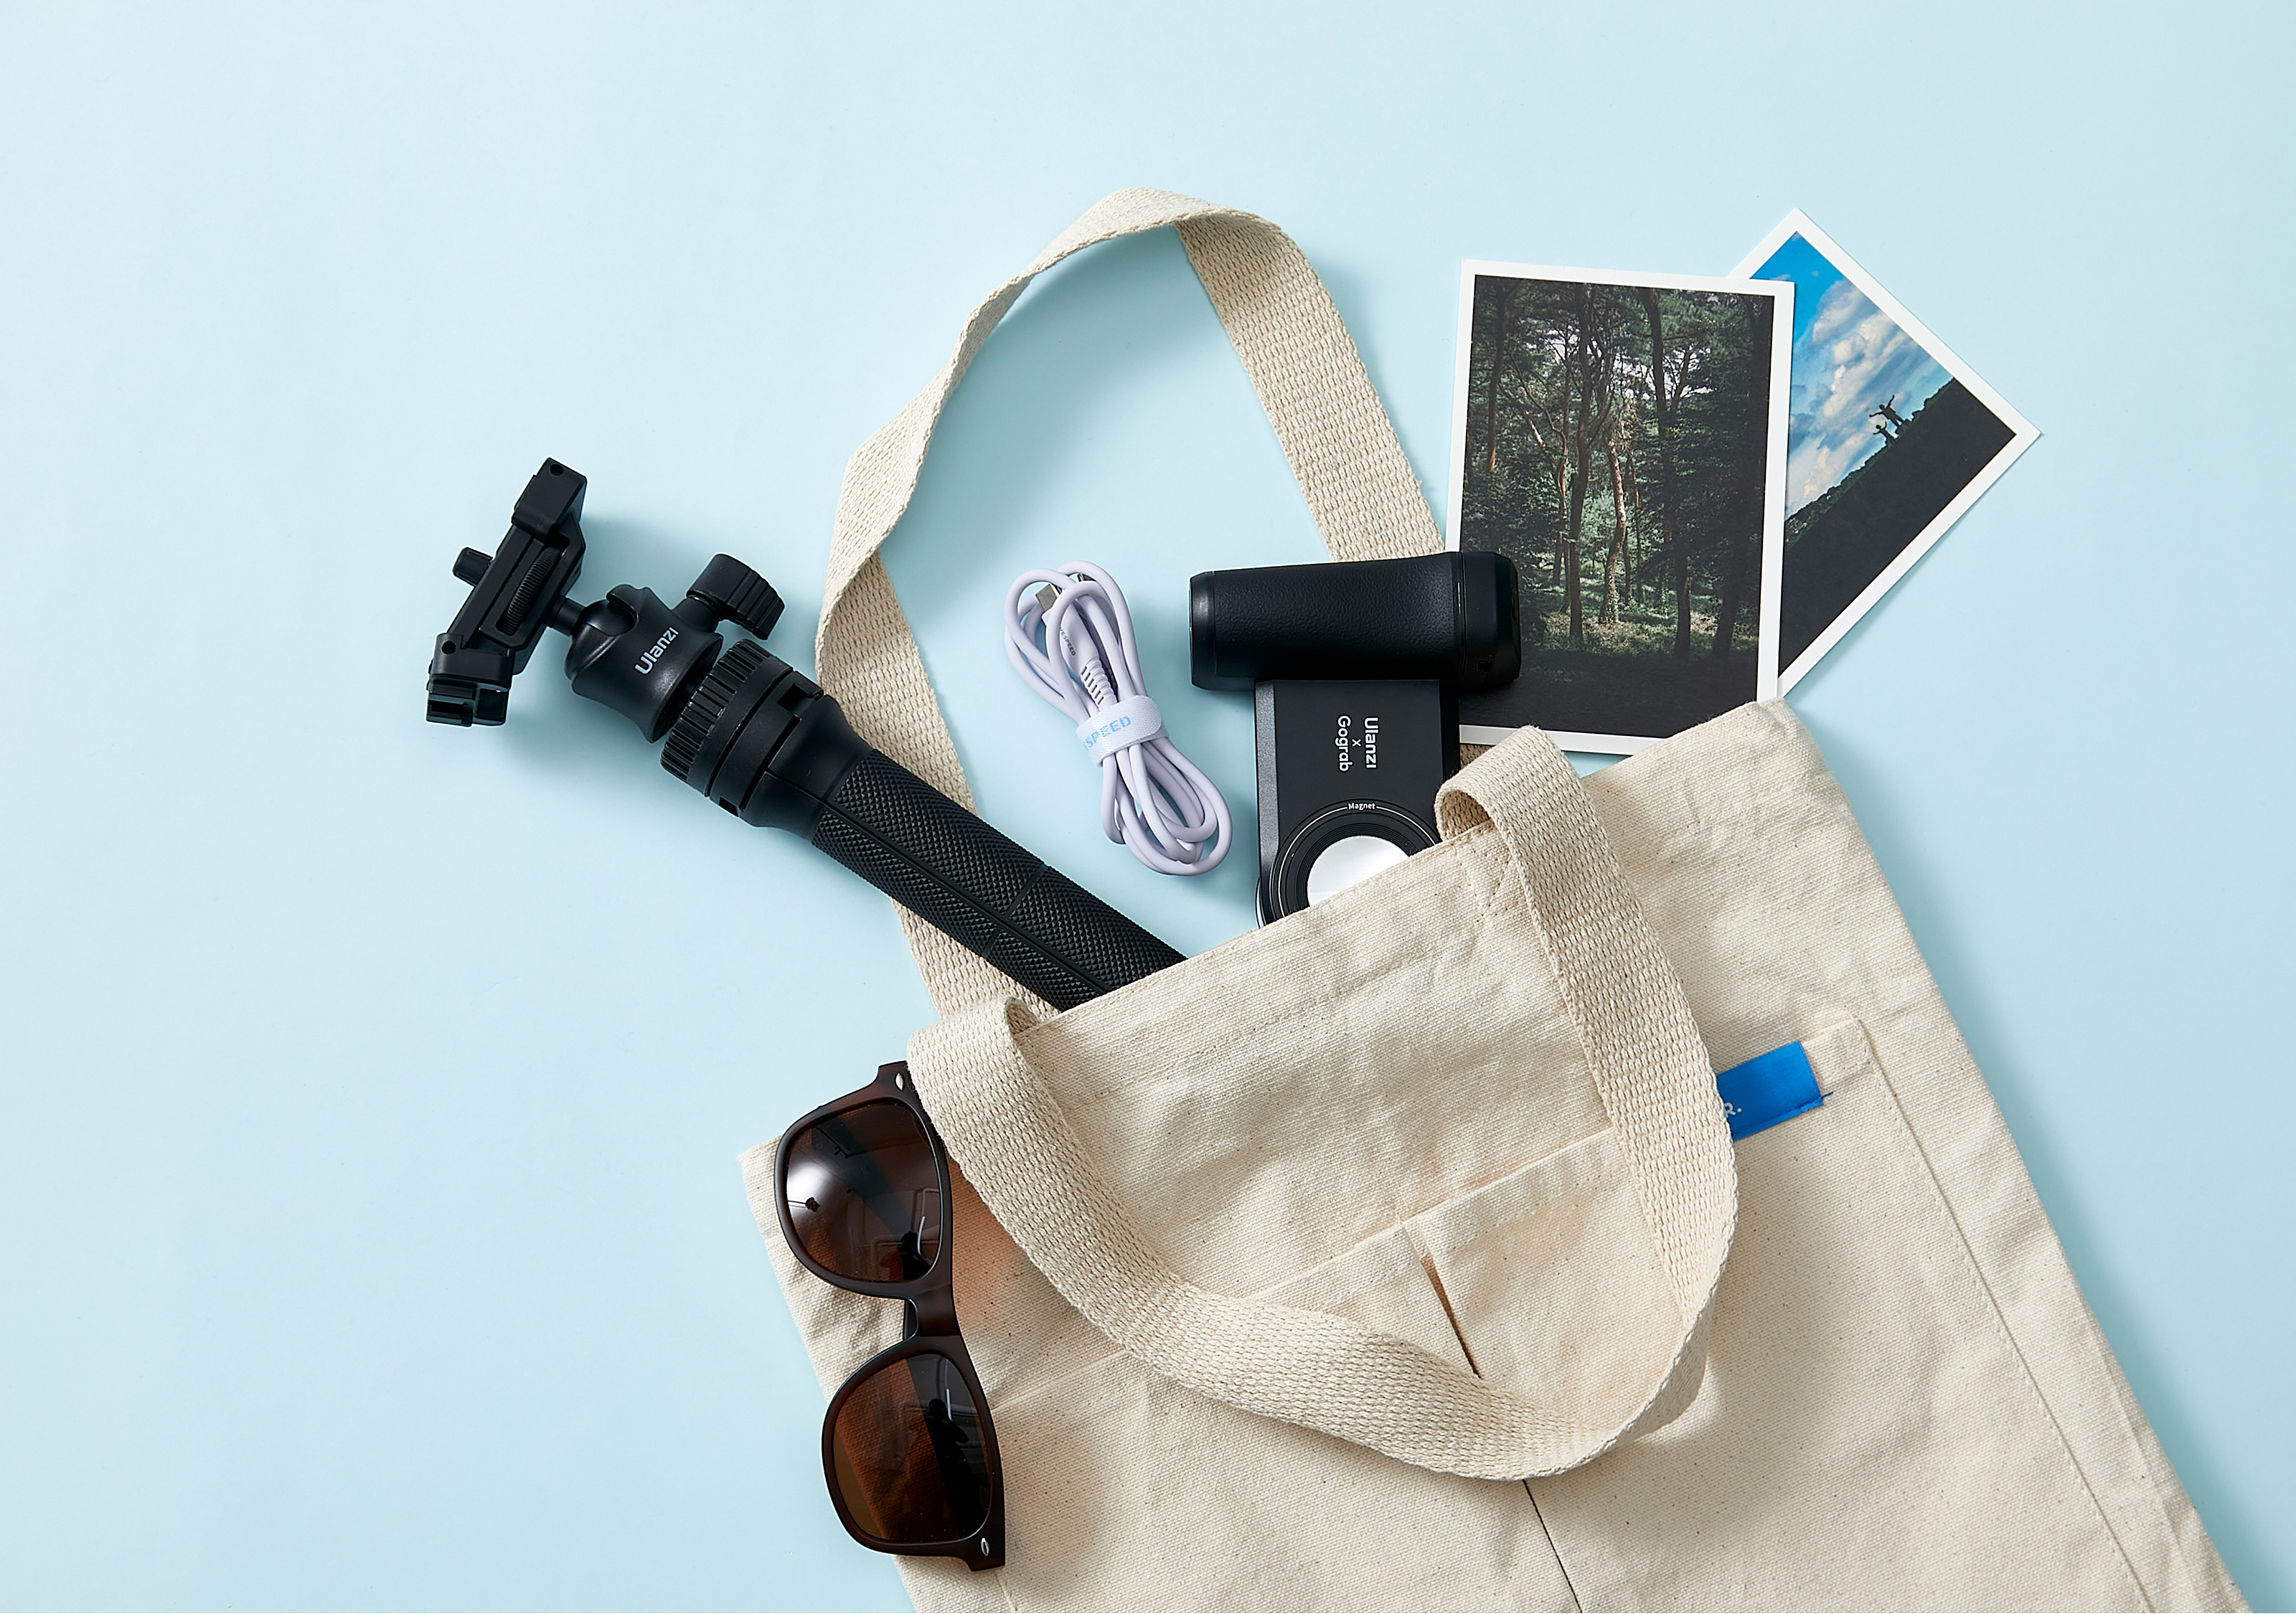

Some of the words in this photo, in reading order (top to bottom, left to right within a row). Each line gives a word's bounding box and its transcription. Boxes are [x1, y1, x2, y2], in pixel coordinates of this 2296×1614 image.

[634, 627, 679, 674] Ulanzi
[1335, 715, 1353, 772] Gograb
[1364, 717, 1379, 768] Ulanzi
[1348, 802, 1375, 811] Magnet
